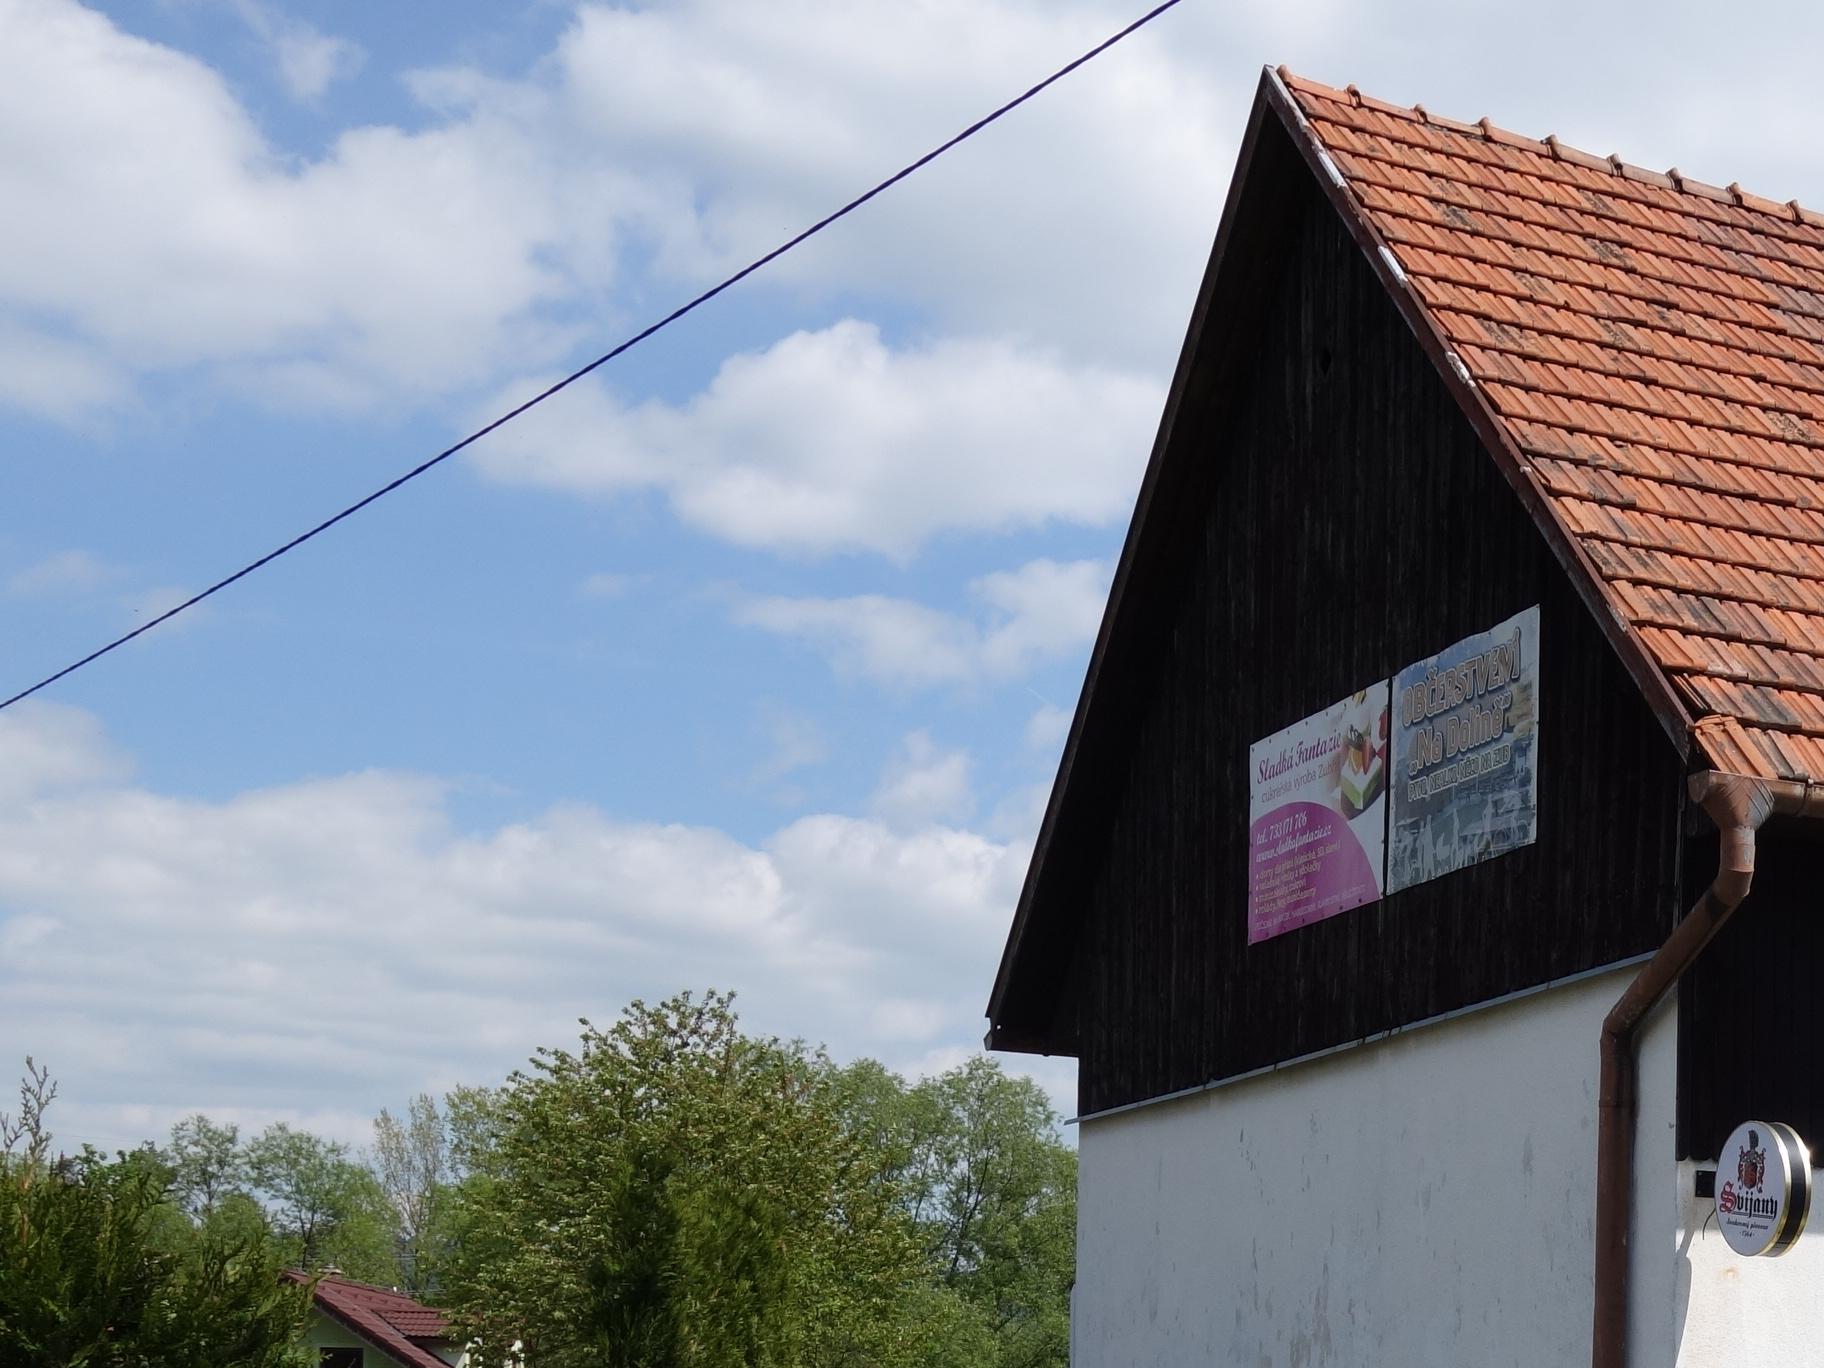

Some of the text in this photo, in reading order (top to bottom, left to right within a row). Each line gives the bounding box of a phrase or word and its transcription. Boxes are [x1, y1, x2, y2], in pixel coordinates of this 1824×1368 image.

[1402, 626, 1521, 727] OBČERSTVENÍ
[1257, 729, 1342, 784] Sladká Fantazie
[1719, 1180, 1778, 1222] Svijany
